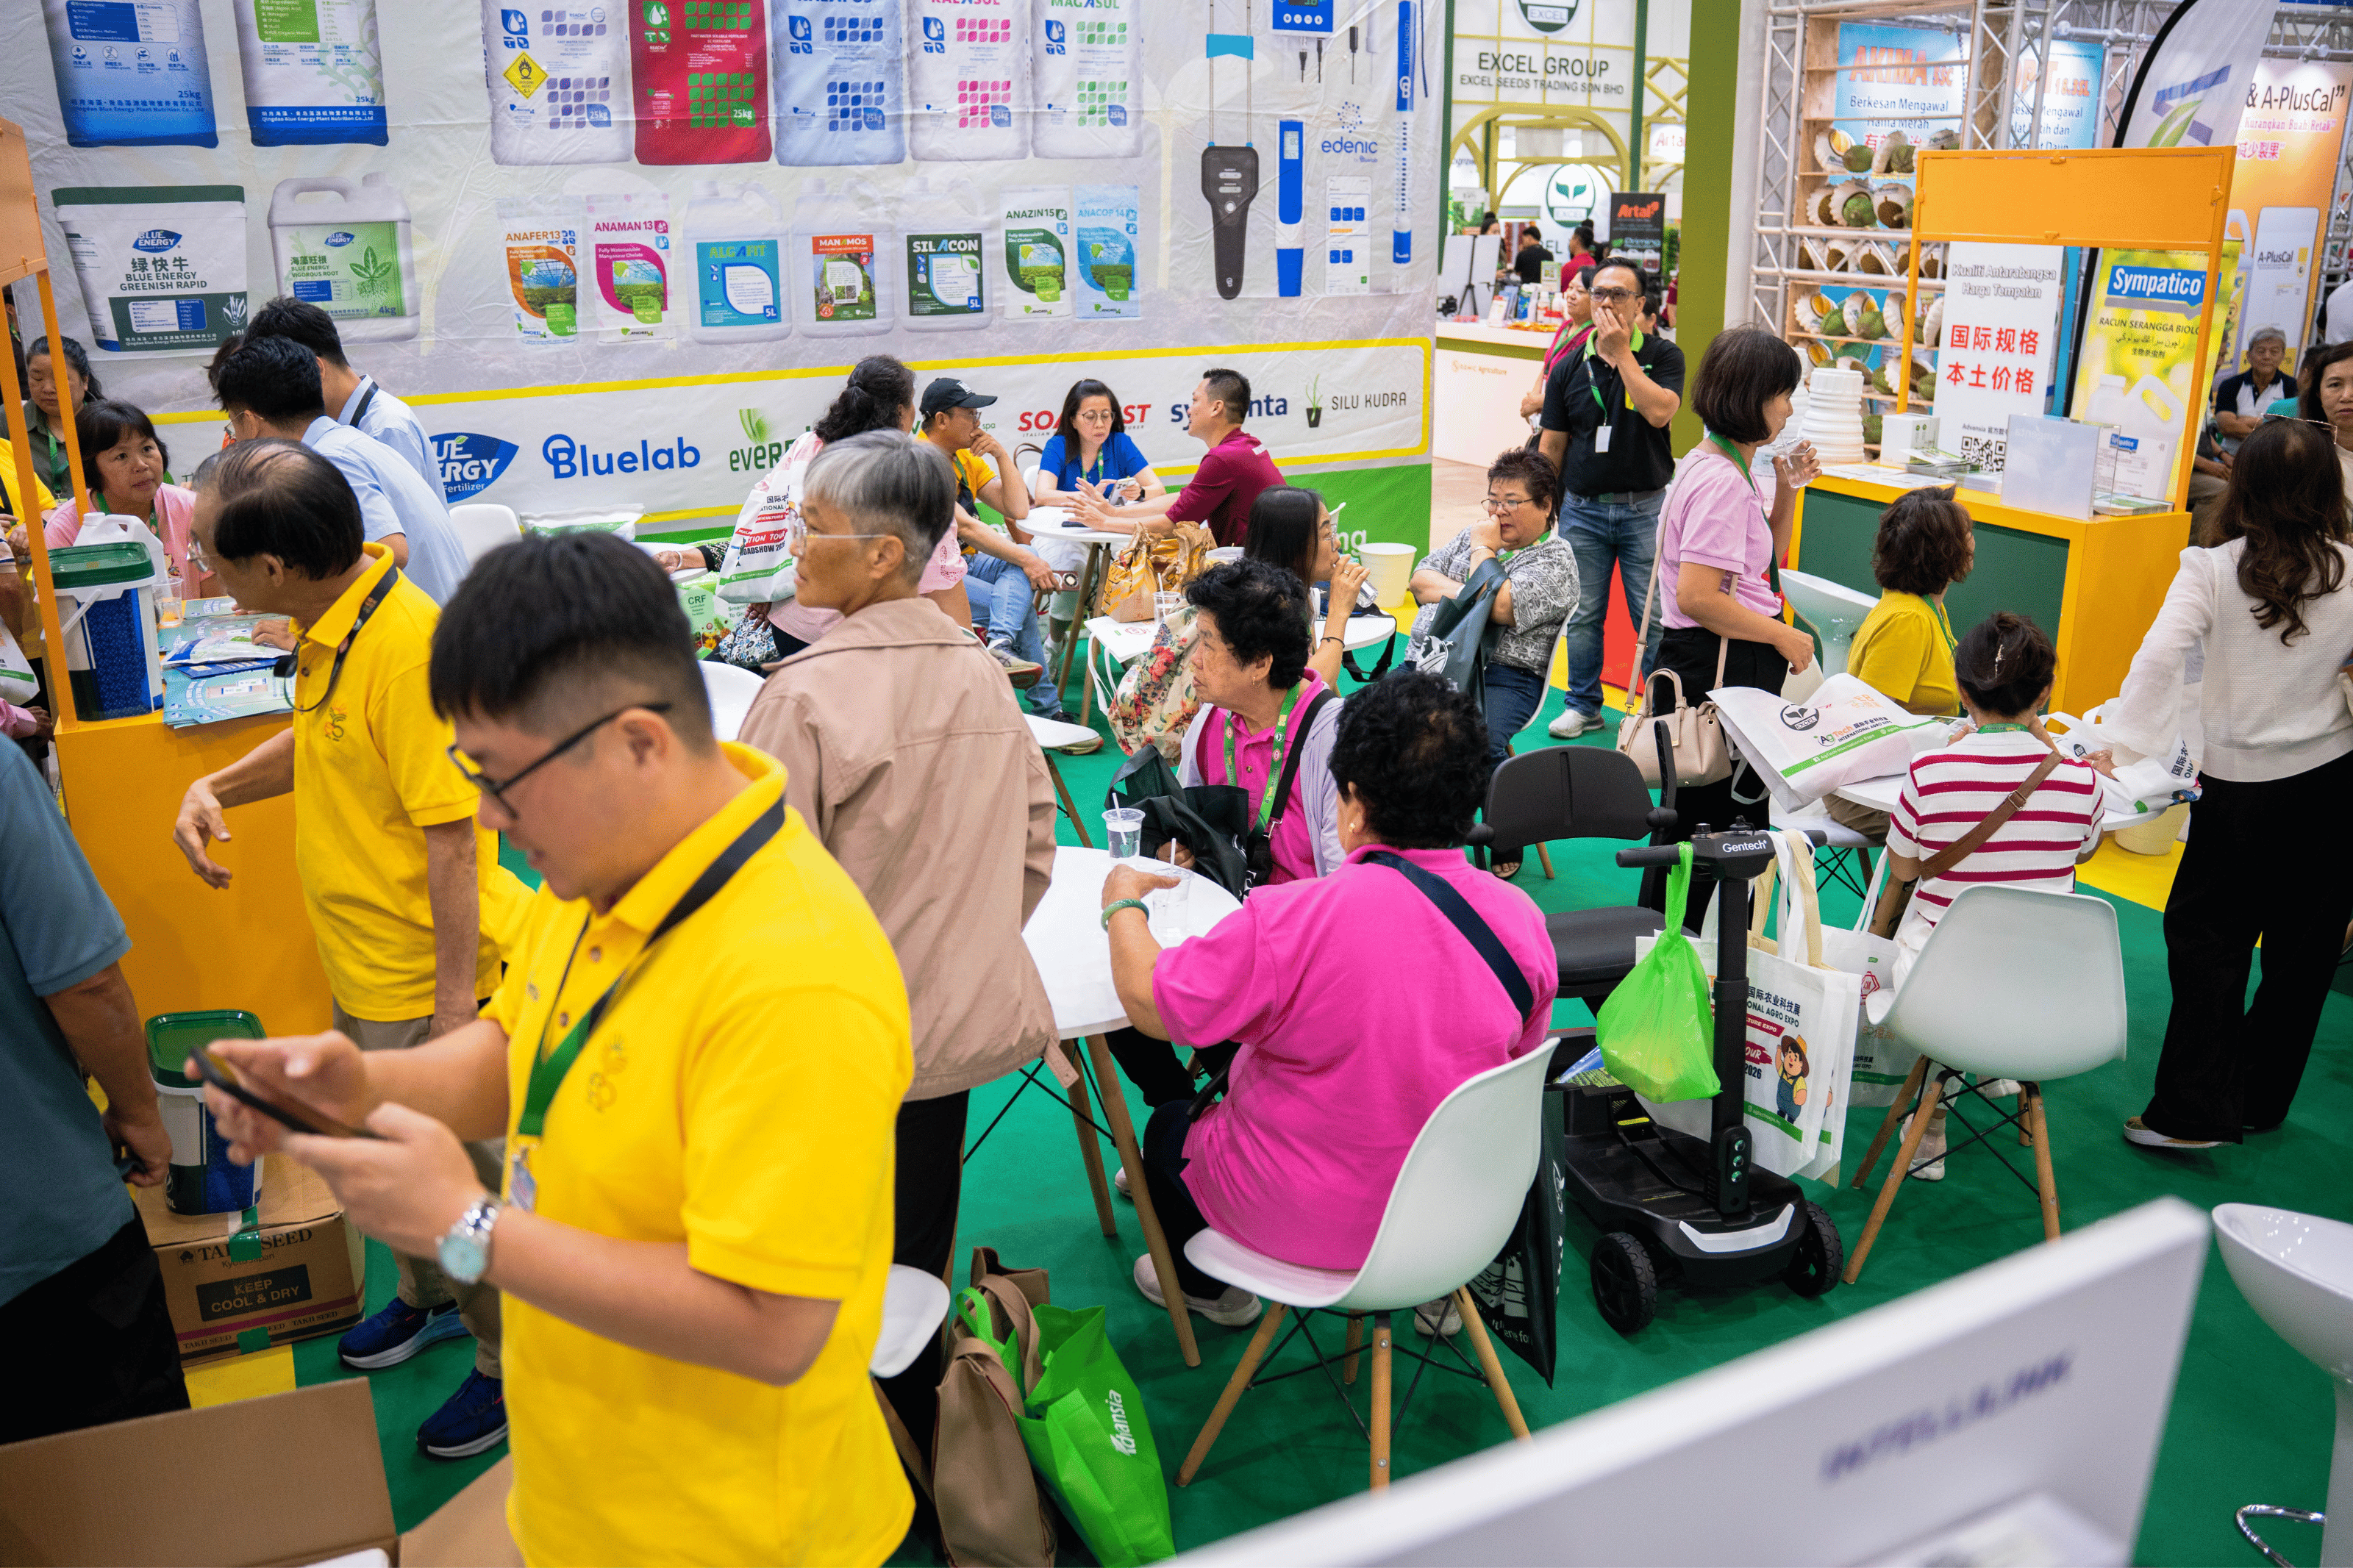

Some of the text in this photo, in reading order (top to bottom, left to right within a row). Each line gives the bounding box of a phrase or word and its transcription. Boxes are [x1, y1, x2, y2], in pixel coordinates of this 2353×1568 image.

[1529, 9, 1567, 21] EXCEL
[1478, 52, 1609, 78] EXCEL GROUP
[1849, 46, 1928, 85] AKIMA
[1460, 74, 1624, 95] EXCEL SEEDS TRADING SDN BHD
[178, 90, 201, 100] 25kg
[355, 96, 376, 104] 25kg
[2246, 83, 2257, 108] &
[1850, 96, 1949, 114] Berkesan Mengawal
[590, 112, 609, 121] 25kg
[733, 110, 752, 120] 25kg
[2043, 106, 2083, 120] engawal
[2053, 124, 2070, 135] dan
[1321, 137, 1378, 154] edenic
[1656, 132, 1685, 148] Arta
[1006, 209, 1054, 219] ANAZIN 15
[594, 221, 653, 232] ANAMAN 13
[138, 231, 166, 240] BLUE
[138, 238, 175, 246] ENERGY
[505, 230, 560, 242] ANAFER 13
[820, 238, 867, 246] MANAMOS
[710, 245, 766, 258] ALGAFIT
[913, 239, 979, 253] SILACON
[290, 255, 327, 265] 海藻旺根
[2257, 251, 2293, 263] A-PlusCal
[131, 257, 189, 273] 绿快牛
[125, 271, 197, 282] BLUE ENERGY
[1952, 263, 2057, 282] Kualiti Antarabangsa
[119, 280, 207, 291] GREENISH RAPID
[2113, 268, 2202, 296] Sympatico
[1962, 282, 2041, 301] Harga Tempatan
[970, 298, 980, 307] 5L
[378, 306, 396, 316] 4kg
[766, 308, 776, 317] 5L
[2099, 317, 2174, 333] RACUN SERANGGA
[1949, 323, 2040, 357] 国际规格
[1946, 361, 2035, 395] 本土价格
[1332, 391, 1407, 411] SILU KUDRA
[1171, 394, 1288, 424] synta
[982, 422, 996, 431] spa
[433, 438, 473, 460] UE
[543, 434, 701, 479] Bluelab
[444, 483, 486, 495] Fertilizer
[767, 495, 790, 504] 国际农
[688, 595, 707, 605] CRF
[1795, 717, 1817, 730] EXCEL
[1819, 725, 1854, 745] AgTech
[1838, 726, 1871, 743] INTERNATIONAL
[1722, 840, 1766, 853] Gentech
[1748, 986, 1802, 1017] 国际农业科技展
[1746, 1000, 1800, 1028] ONAL AGRO EXPO
[1763, 1023, 1777, 1033] EXPO
[1746, 1046, 1762, 1060] OUR
[260, 1228, 313, 1250] SEED
[233, 1278, 274, 1295] KEEP
[211, 1285, 300, 1313] COOL & DRY
[316, 1311, 338, 1321] SEED
[268, 1322, 285, 1332] EED
[210, 1333, 232, 1345] SEED
